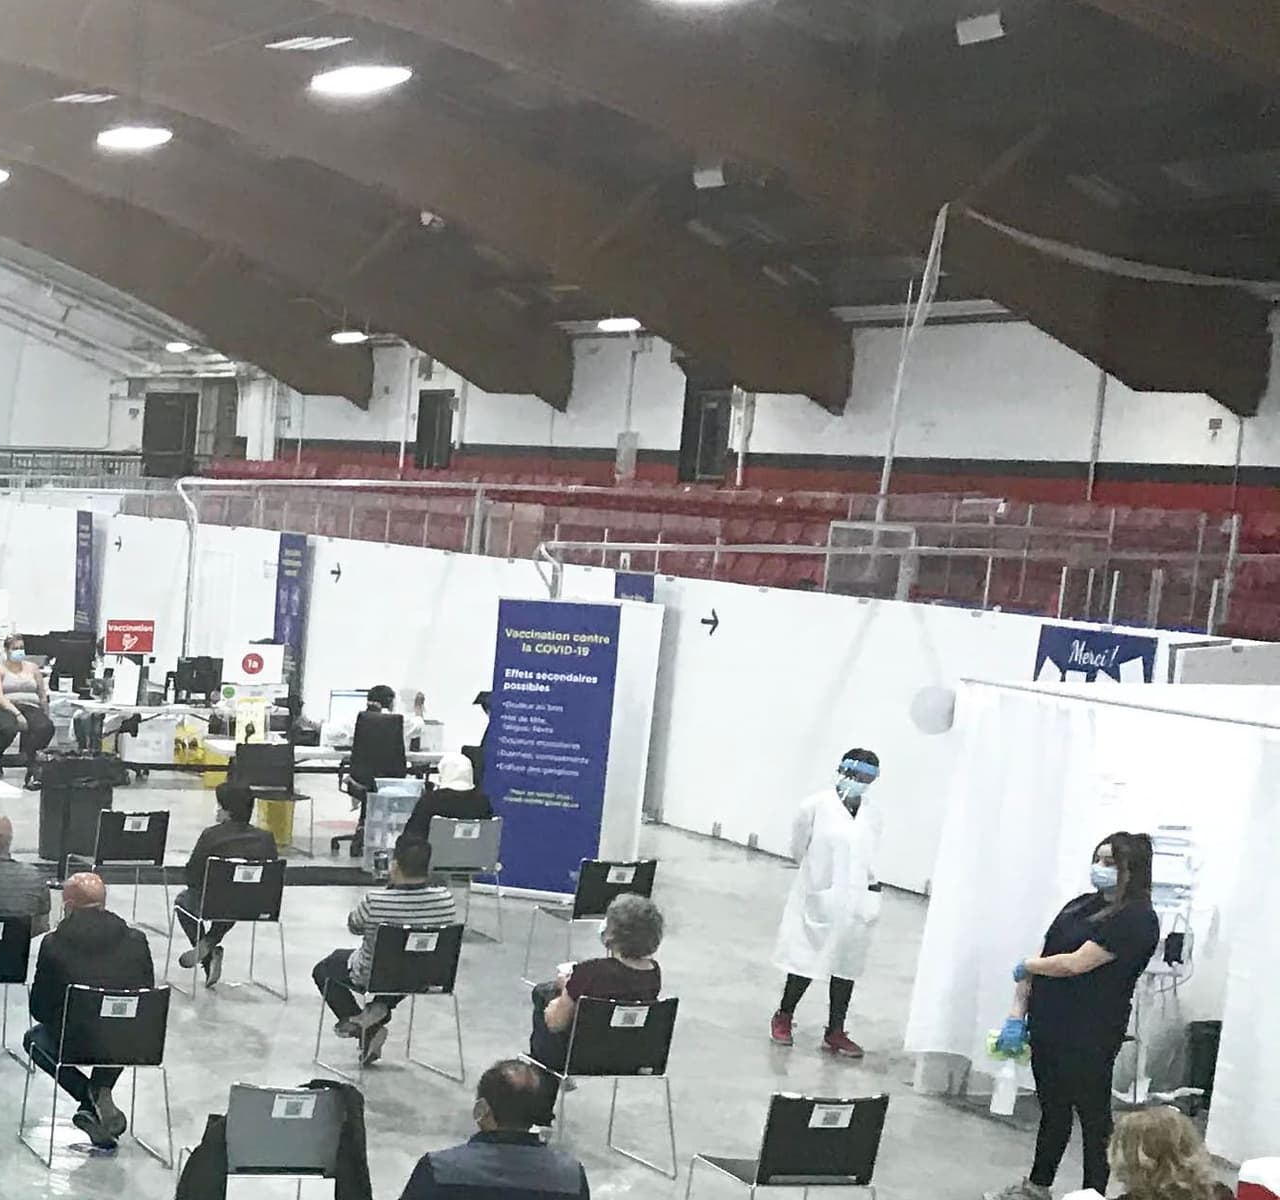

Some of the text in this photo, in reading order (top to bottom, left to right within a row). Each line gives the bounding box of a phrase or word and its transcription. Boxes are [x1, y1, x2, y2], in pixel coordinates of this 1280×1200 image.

[505, 628, 610, 644] Vaccination contre
[522, 642, 590, 656] la COVID-19
[504, 668, 598, 684] Effets secondaires
[503, 681, 551, 692] possibles
